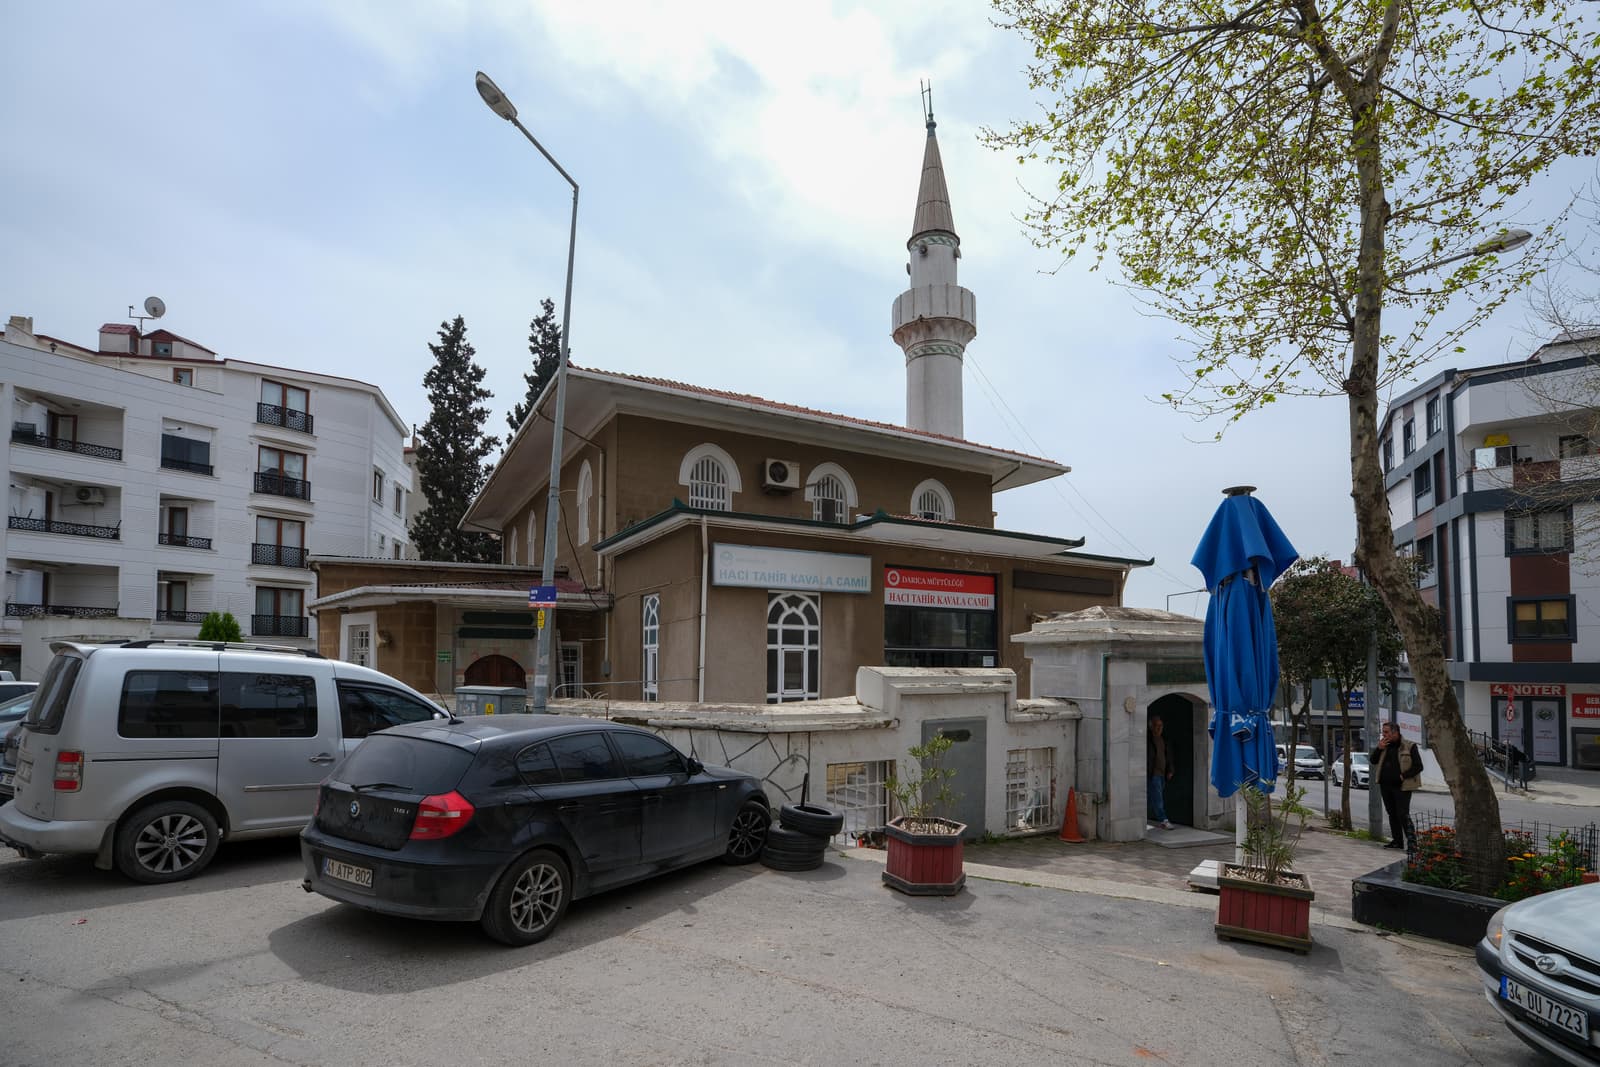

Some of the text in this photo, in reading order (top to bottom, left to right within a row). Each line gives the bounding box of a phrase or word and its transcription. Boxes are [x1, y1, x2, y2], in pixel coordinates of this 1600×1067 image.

[719, 569, 749, 581] HACI
[752, 570, 786, 583] TAHİR
[889, 592, 909, 603] HACI
[911, 593, 935, 605] TAHİR
[937, 595, 966, 607] KAVALA
[1511, 685, 1562, 695] NOTER
[337, 863, 354, 879] ATP
[355, 868, 371, 885] 802
[1508, 982, 1522, 1004] 34
[1527, 991, 1542, 1014] DU
[1546, 1000, 1583, 1033] 7223
